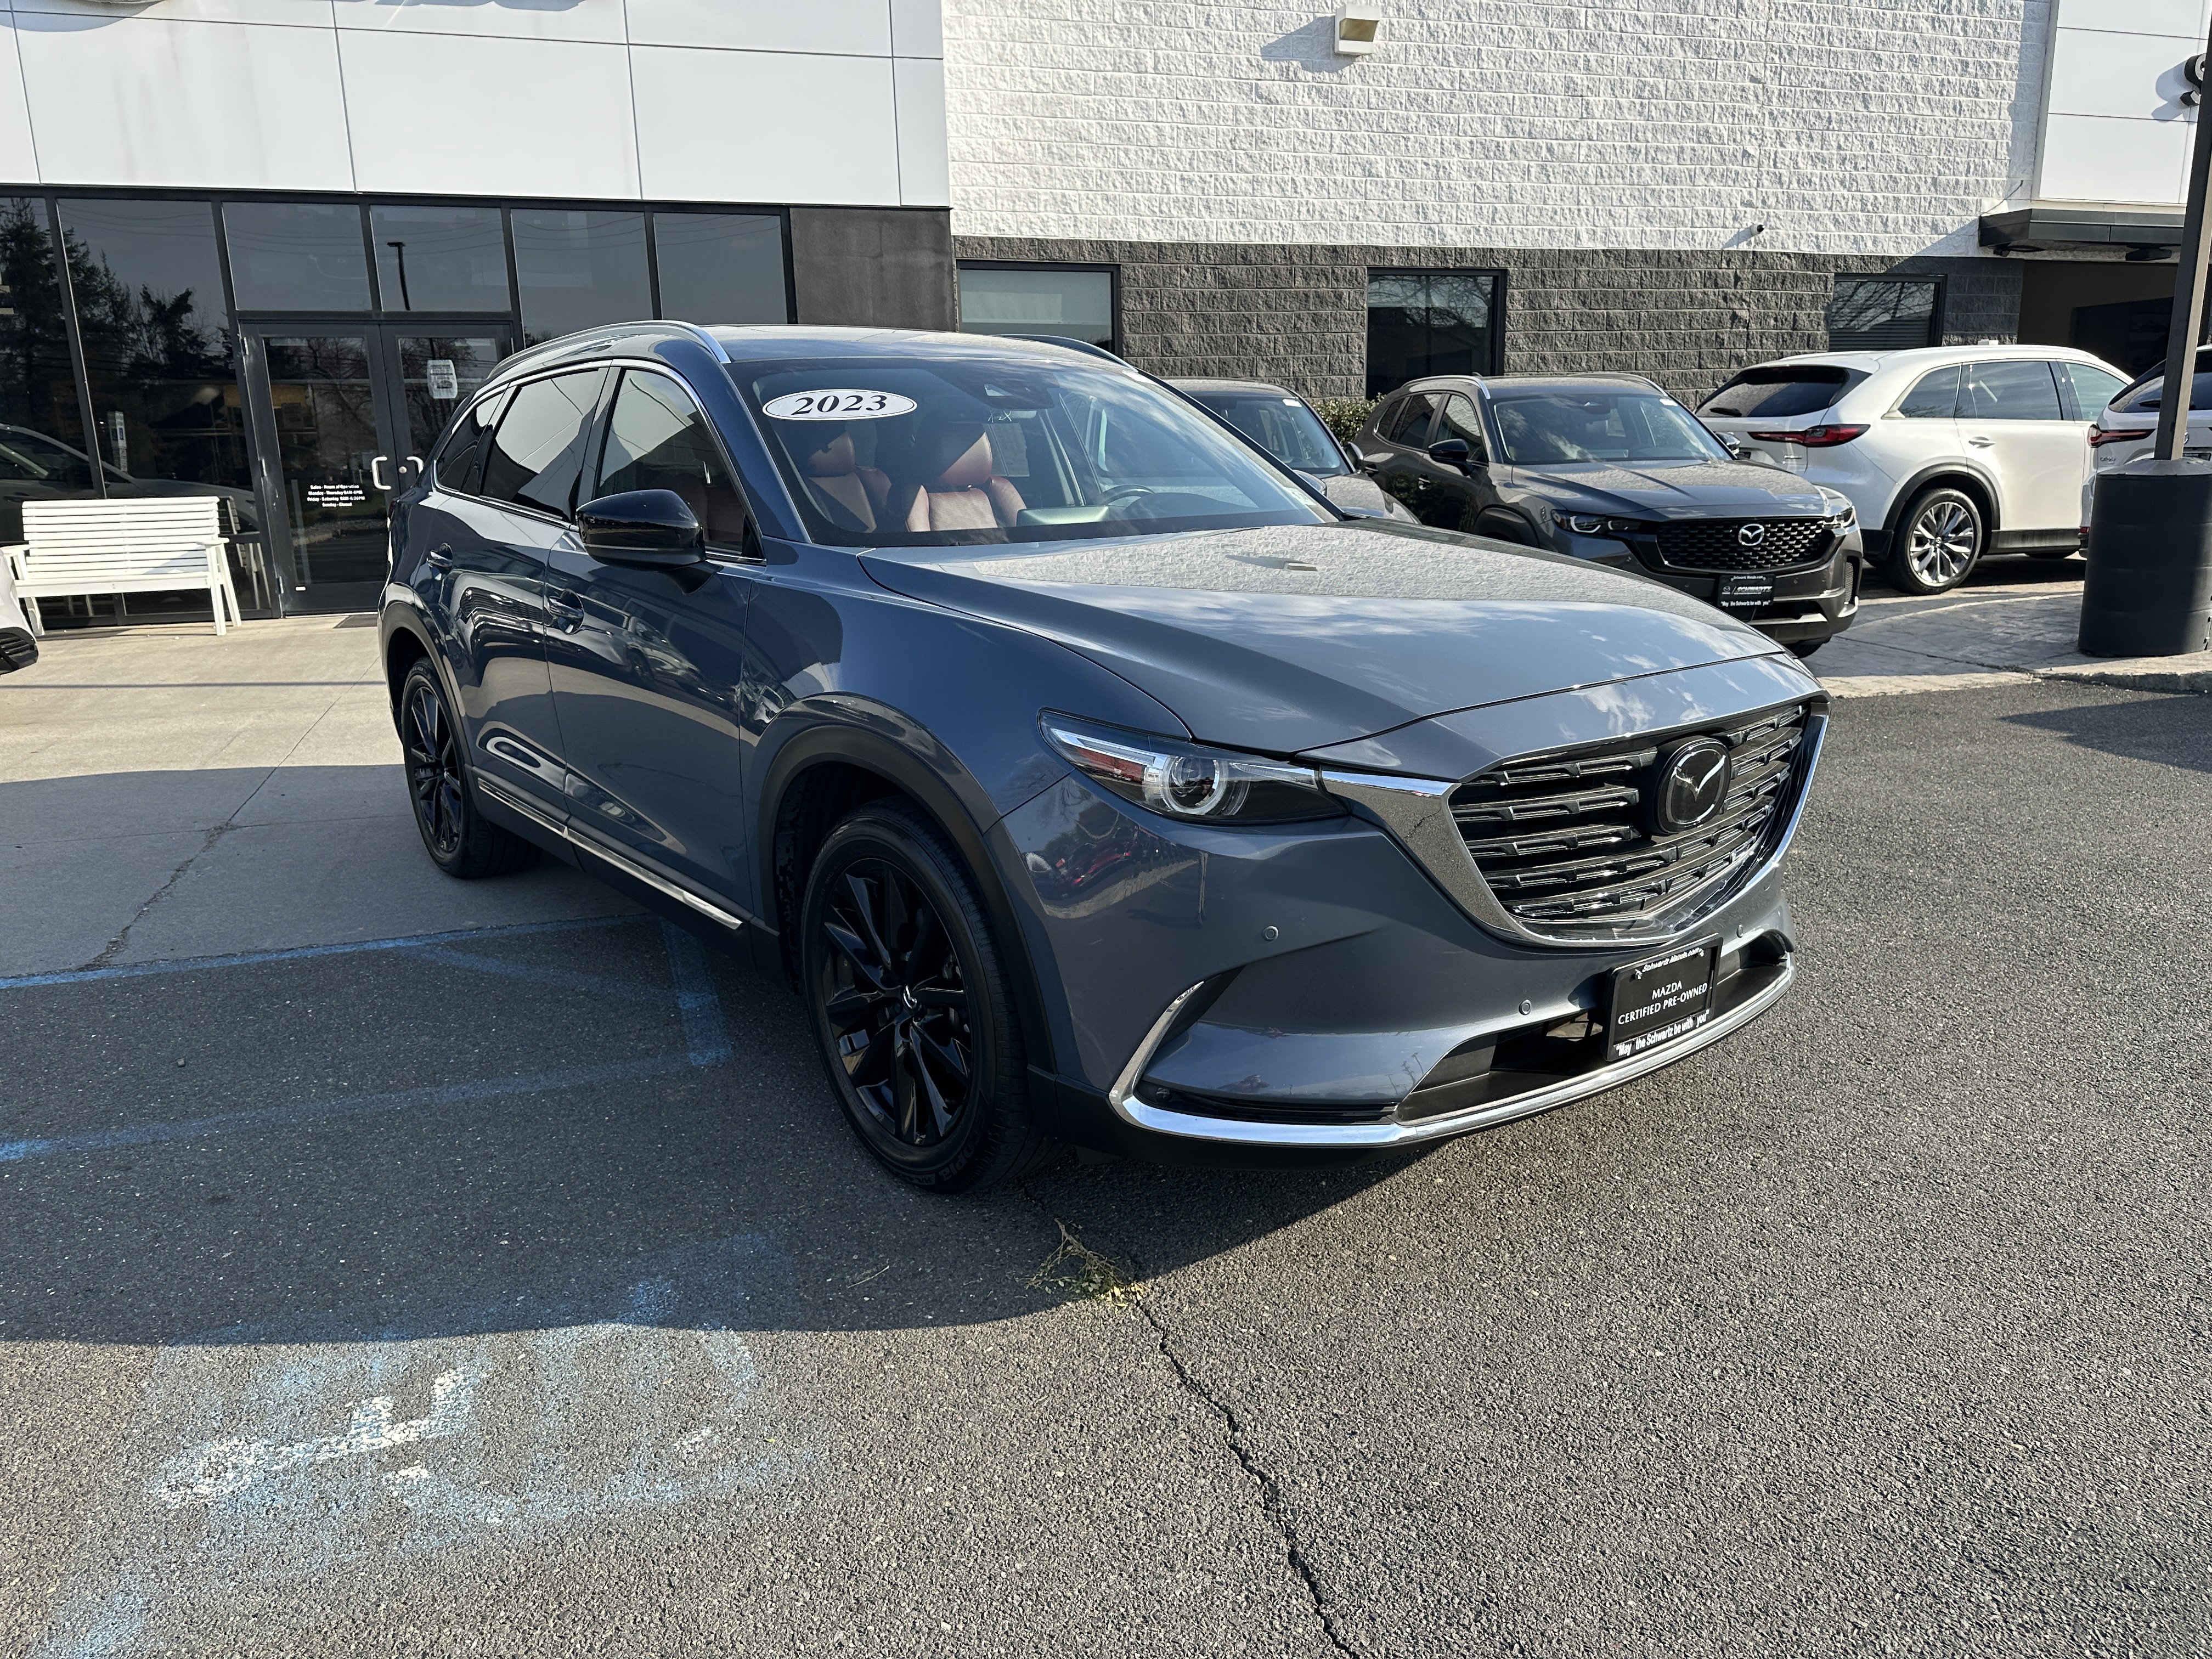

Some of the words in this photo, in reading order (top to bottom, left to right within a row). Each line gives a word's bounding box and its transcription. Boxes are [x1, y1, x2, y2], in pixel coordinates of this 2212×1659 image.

[791, 394, 887, 415] 2023
[1618, 1002, 1661, 1025] CERTIFIED
[1663, 983, 1708, 1009] PRE-OWNED
[1652, 980, 1683, 1000] MAZDA
[1616, 1042, 1632, 1056] "May
[1635, 1037, 1646, 1050] the
[1646, 1025, 1673, 1046] Schwartz
[1673, 1023, 1681, 1035] be
[1681, 1018, 1694, 1031] with
[1696, 1009, 1710, 1028] you"
